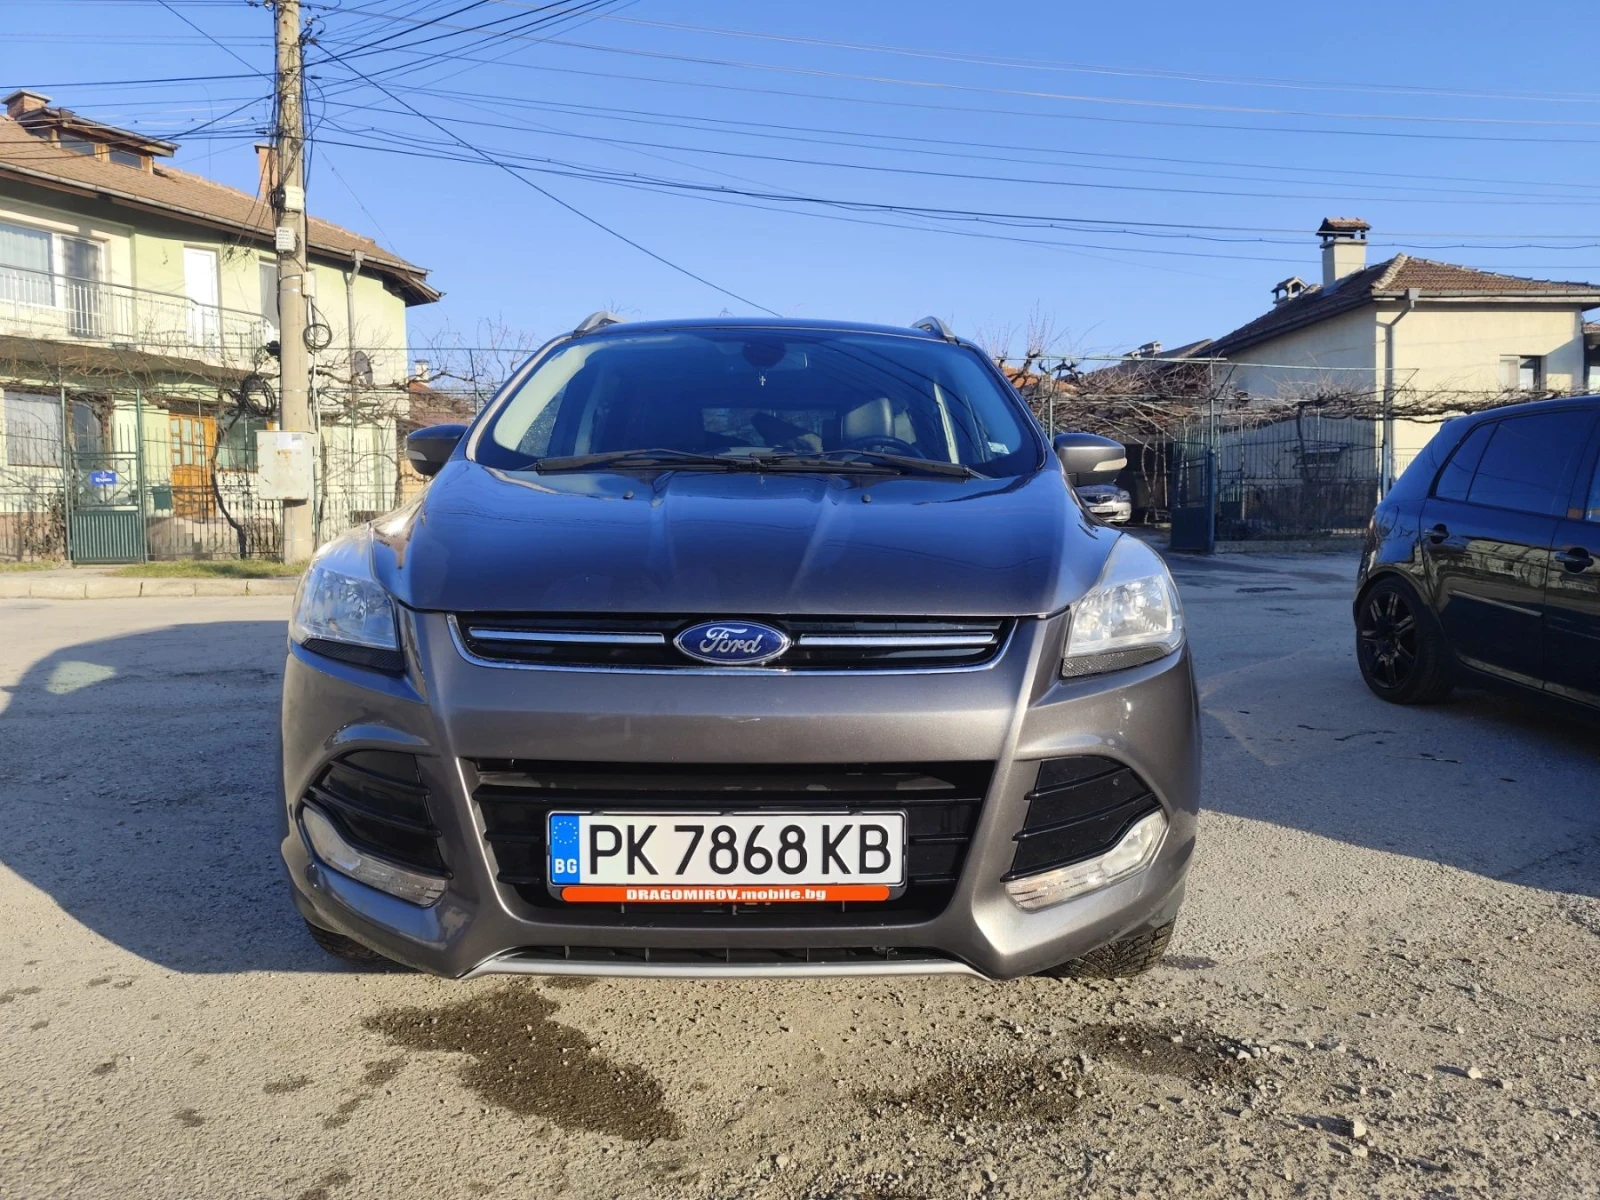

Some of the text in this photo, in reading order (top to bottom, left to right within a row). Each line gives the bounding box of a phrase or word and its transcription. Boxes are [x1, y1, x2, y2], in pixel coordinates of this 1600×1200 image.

[700, 626, 763, 654] Ford
[589, 824, 892, 875] PK 7868 KB
[554, 858, 578, 874] BG
[625, 888, 827, 901] DRAGOMIROV.mobile.bg
